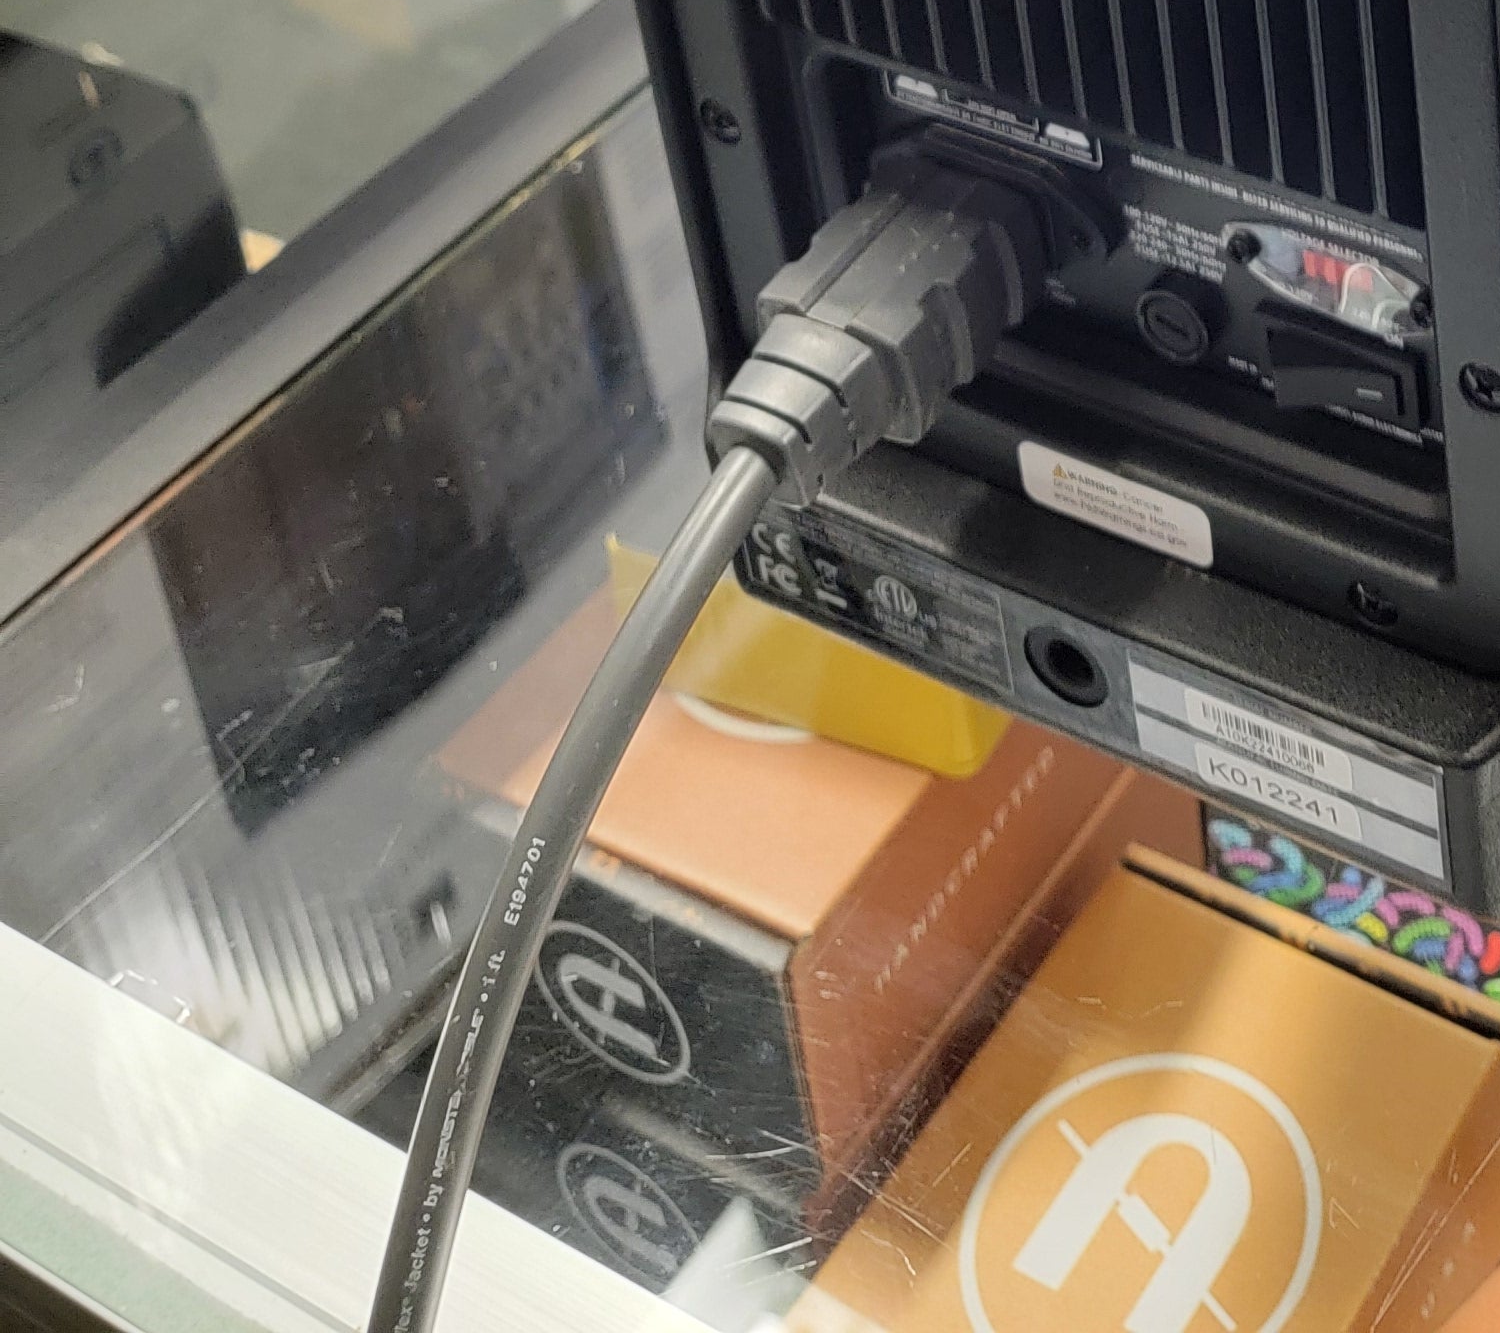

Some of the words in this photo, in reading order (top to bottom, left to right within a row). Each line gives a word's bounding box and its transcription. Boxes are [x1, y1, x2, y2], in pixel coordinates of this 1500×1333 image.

[1208, 756, 1339, 826] K012241
[503, 835, 547, 927] E194701
[431, 1083, 466, 1179] MONSTE
[423, 1183, 445, 1208] by
[404, 1227, 432, 1294] Jacket
